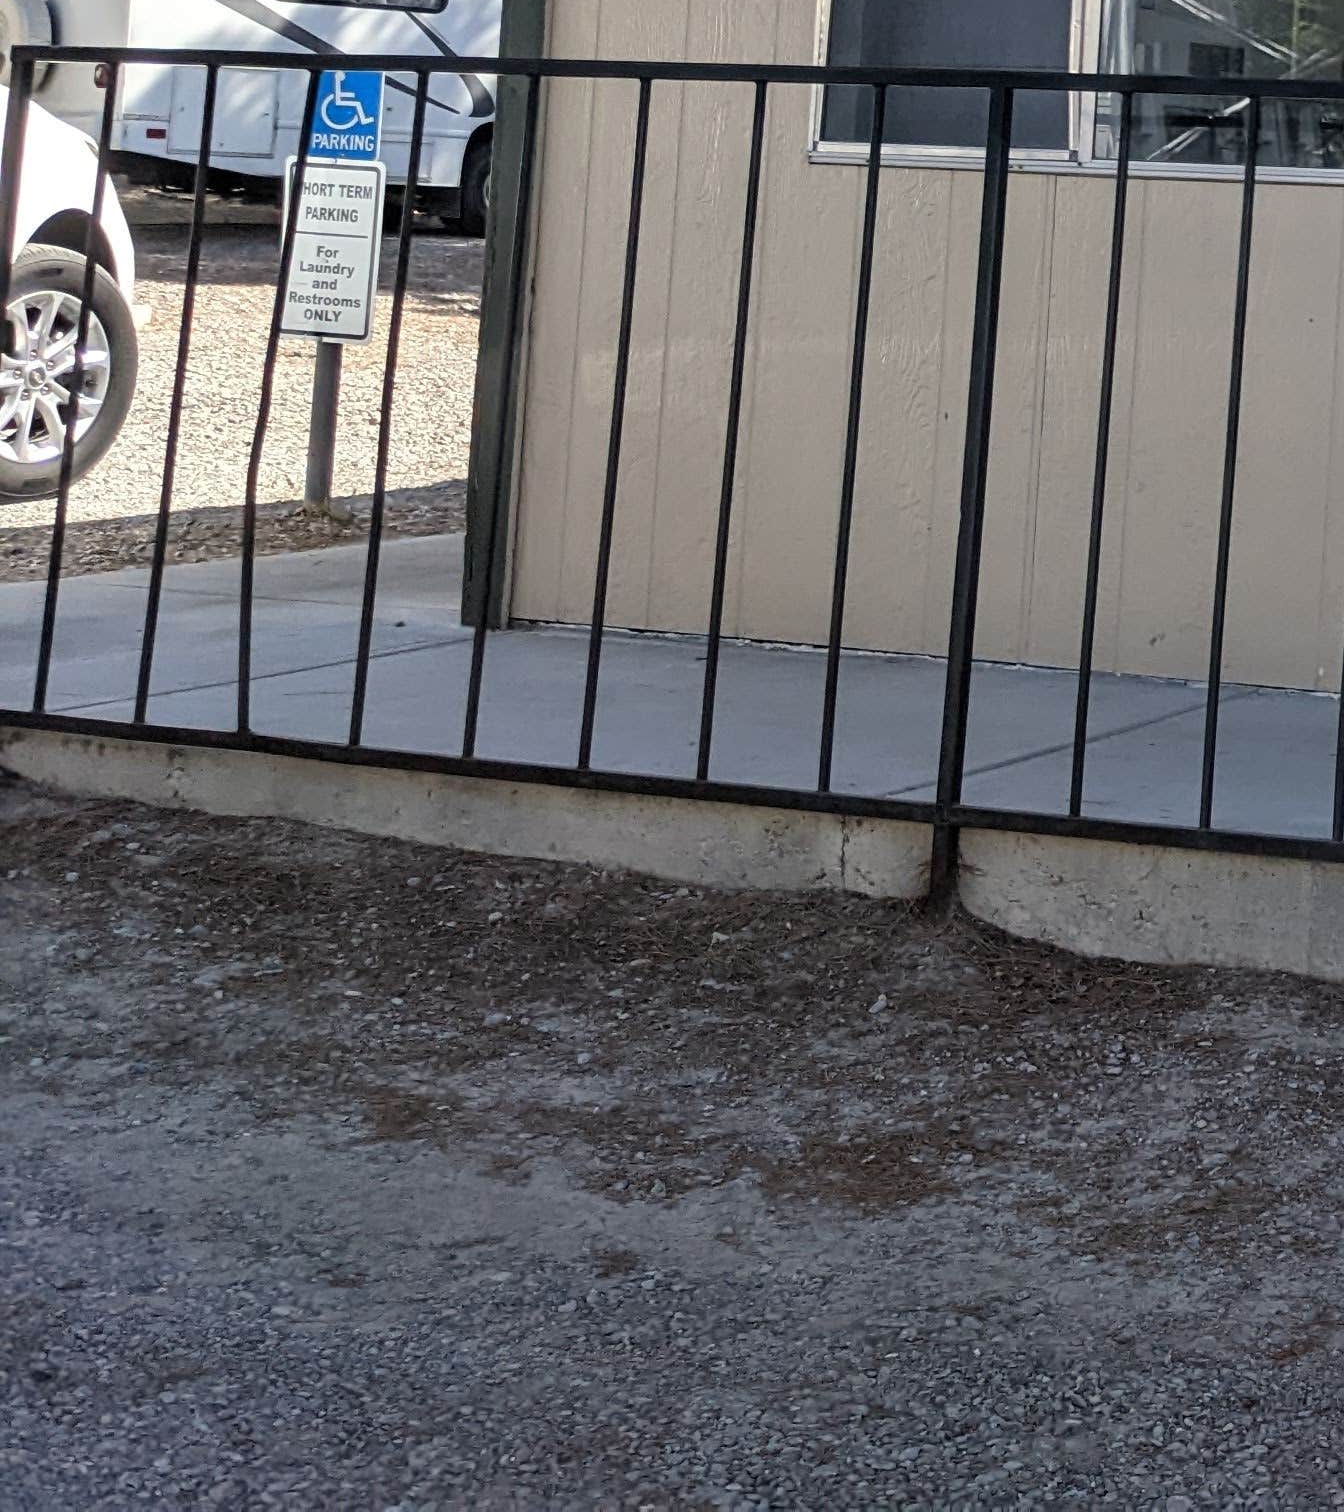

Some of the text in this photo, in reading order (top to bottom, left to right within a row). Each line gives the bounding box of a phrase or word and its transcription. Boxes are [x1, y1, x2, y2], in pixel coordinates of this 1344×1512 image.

[312, 133, 375, 152] PARKING
[302, 181, 373, 200] HORT TERM
[305, 206, 359, 223] PARKING
[316, 245, 340, 259] For
[299, 261, 355, 279] Laundry
[311, 279, 338, 290] and
[288, 291, 361, 308] Restrooms
[303, 308, 343, 323] ONLY
